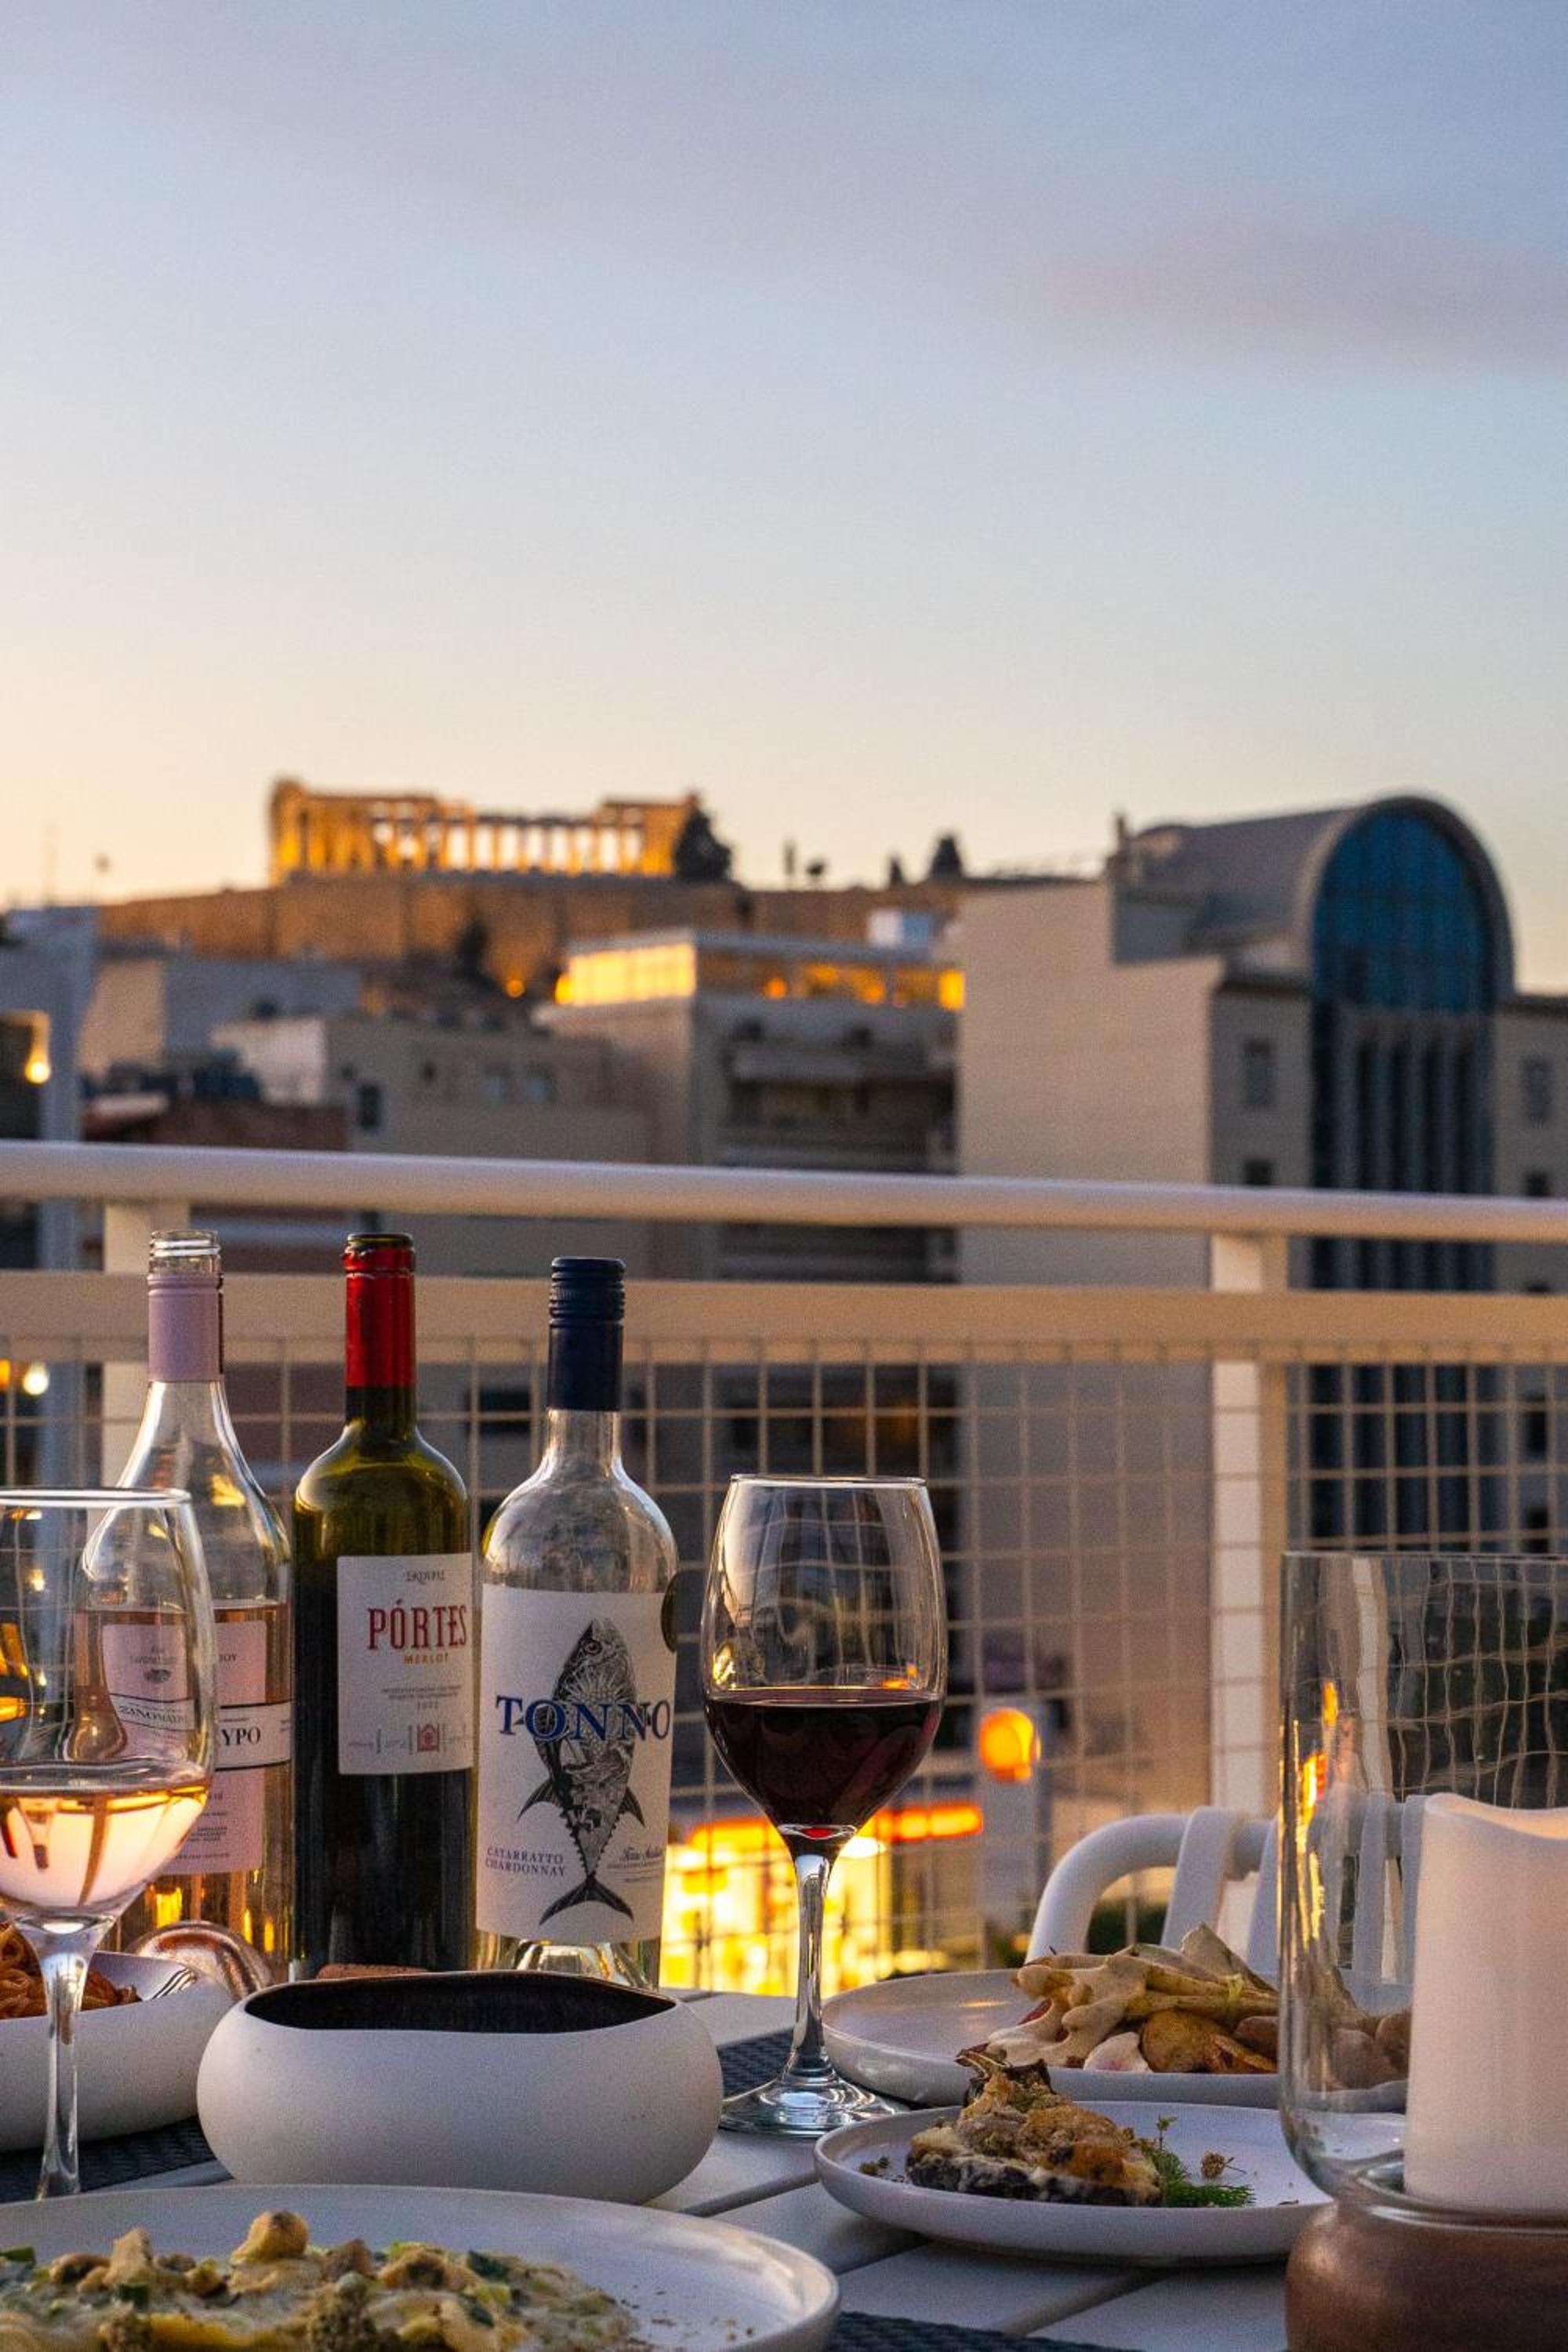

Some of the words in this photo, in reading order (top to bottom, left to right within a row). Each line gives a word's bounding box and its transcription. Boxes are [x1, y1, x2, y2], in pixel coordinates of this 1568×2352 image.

[495, 1695, 671, 1742] TONNO
[487, 1847, 564, 1864] CATARRATTO
[485, 1858, 565, 1877] CHARDONNAY
